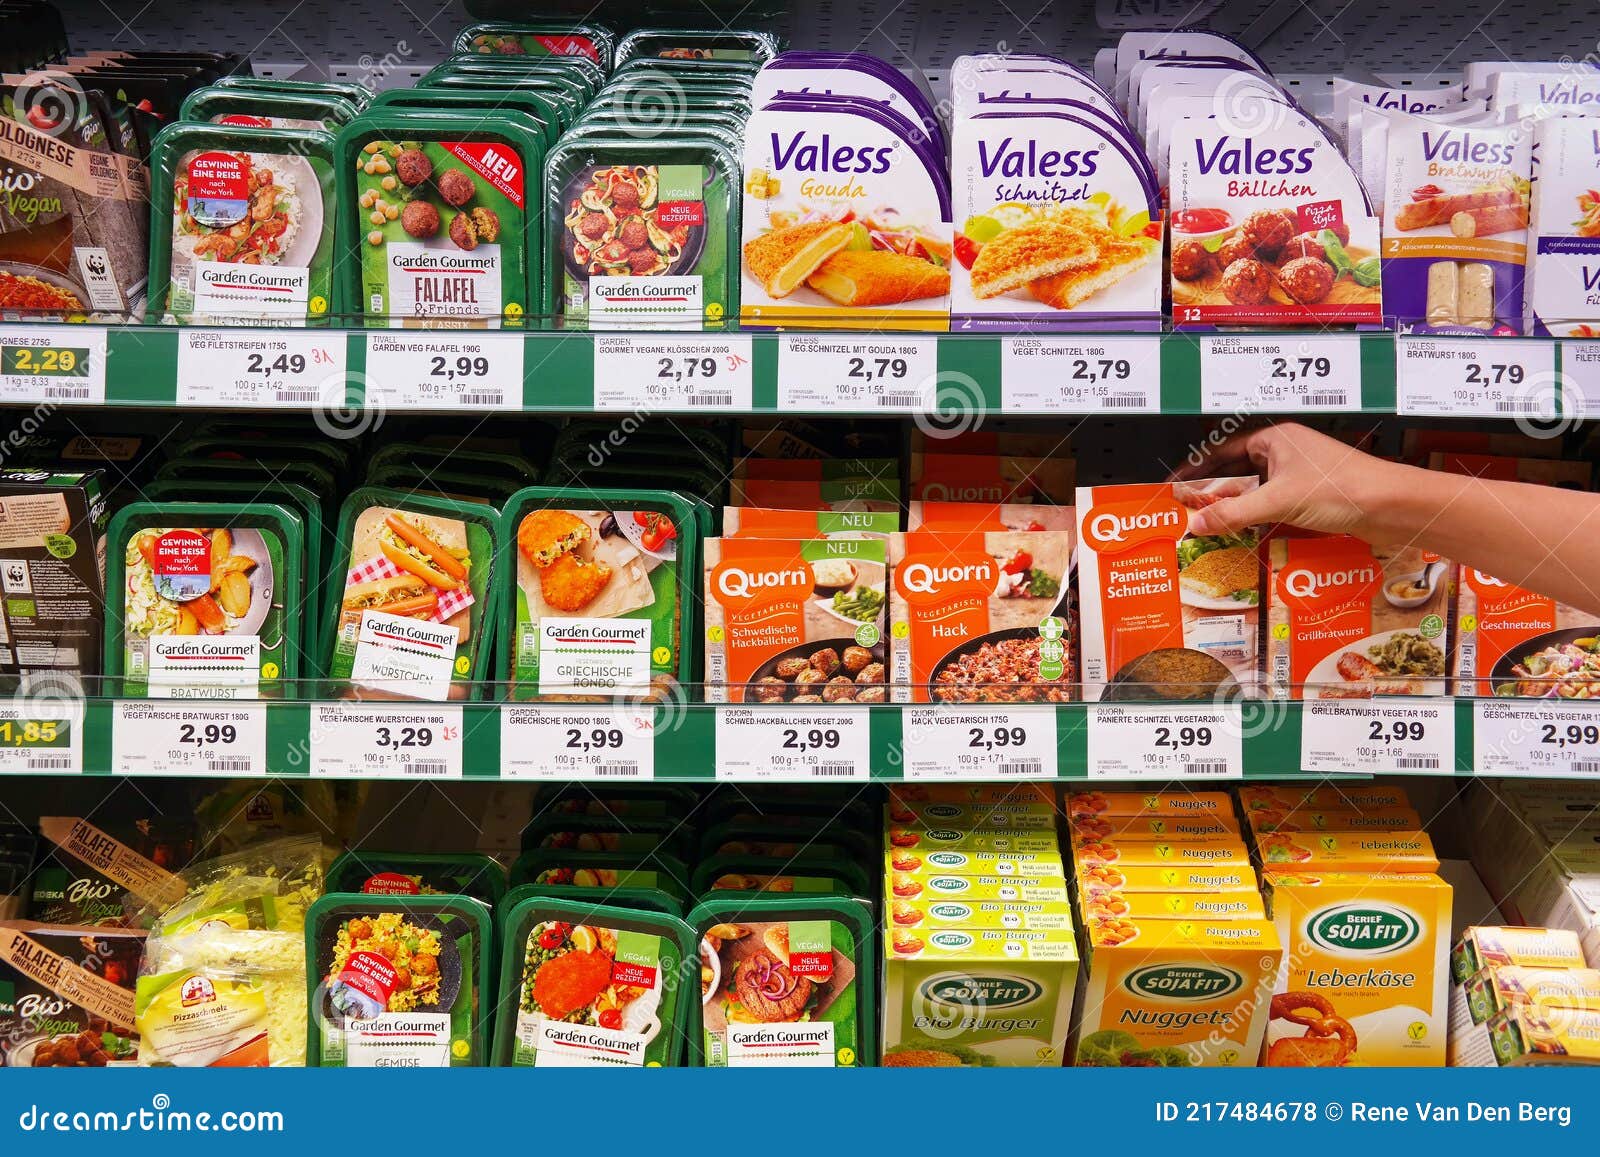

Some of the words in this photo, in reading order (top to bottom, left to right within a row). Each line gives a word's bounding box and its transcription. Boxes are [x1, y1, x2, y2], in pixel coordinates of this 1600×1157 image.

[771, 131, 892, 174] Valess
[1422, 130, 1515, 165] Valess
[978, 138, 1099, 178] Valess
[1195, 136, 1315, 175] Valess
[195, 160, 239, 170] GEWINNE
[481, 148, 518, 182] NEU
[192, 169, 214, 179] EINE
[216, 170, 242, 180] REISE
[209, 180, 226, 188] nach
[800, 176, 868, 198] Gouda
[1227, 180, 1317, 197] Bällchen
[200, 187, 215, 196] New
[217, 188, 234, 197] York
[666, 189, 695, 197] VEGAN
[995, 183, 1091, 203] Schnitzel
[392, 252, 438, 269] Garden
[440, 255, 495, 270] Gourmet
[202, 269, 246, 284] Garden
[250, 274, 303, 287] Gourmet
[415, 278, 478, 303] FALAFEL
[596, 284, 639, 296] Garden
[642, 284, 696, 296] Gourmet
[1184, 309, 1200, 320] 12
[31, 338, 51, 346] 275G
[373, 344, 406, 352] GARDEN
[790, 345, 851, 353] VEG.SCHNITZEL
[868, 346, 896, 354] GOUDA
[1407, 342, 1435, 350] VALESS
[1041, 348, 1084, 356] SCHNITZEL
[1086, 348, 1104, 356] 180G
[1407, 351, 1455, 359] BRATWURST
[1458, 352, 1476, 360] 180G
[248, 354, 306, 377] 2,49
[430, 356, 489, 380] 2,99
[658, 358, 717, 382] 2,79
[848, 358, 907, 381] 2,79
[1072, 360, 1130, 384] 2,79
[1272, 358, 1331, 382] 2,79
[1466, 364, 1524, 387] 2,79
[434, 385, 439, 393] g
[450, 384, 465, 393] 1,57
[842, 515, 873, 527] NEU
[1091, 510, 1179, 542] Quorn
[161, 539, 202, 547] GEWINNE
[827, 543, 859, 554] NEU
[158, 548, 180, 556] EINE
[182, 548, 206, 556] REISE
[174, 556, 191, 564] nach
[1112, 556, 1163, 567] FLEISCHFREI
[166, 564, 181, 572] New
[182, 564, 199, 572] York
[1110, 568, 1167, 583] Panierte
[718, 567, 807, 597] Quorn
[903, 563, 991, 594] Quorn
[1285, 566, 1375, 598] Quorn
[1107, 580, 1172, 599] Schnitzel
[731, 602, 799, 622] VEGETARISCH
[917, 599, 983, 618] VEGETARISCH
[546, 624, 589, 639] Garden
[592, 627, 646, 639] Gourmet
[731, 624, 798, 637] Schwedische
[932, 623, 968, 637] Hack
[1480, 619, 1551, 630] Geschnetzeltes
[366, 619, 405, 635] Garden
[407, 625, 454, 646] Gourmet
[156, 642, 199, 656] Garden
[201, 644, 254, 655] Gourmet
[732, 635, 800, 649] Hackbällchen
[556, 665, 633, 677] GRIECHISCHE
[122, 712, 180, 720] VEGETARISCHE
[182, 712, 229, 721] BRATWURST
[231, 713, 249, 721] 180G
[320, 715, 374, 723] VEGETARISCHE
[376, 716, 425, 724] WUERSTCHEN
[1312, 707, 1380, 717] GRILLBRATWURST
[1383, 709, 1418, 717] VEGETAR
[1484, 711, 1553, 720] GESCHNETZELTES
[912, 717, 933, 725] HACK
[991, 716, 1008, 724] 175G
[1097, 716, 1132, 724] PANIERTE
[179, 724, 236, 748] 2,99
[376, 728, 432, 750] 3,29
[969, 728, 1026, 751] 2,99
[1155, 728, 1212, 750] 2,99
[1369, 721, 1424, 744] 2,99
[1541, 725, 1599, 747] 2,99
[566, 729, 623, 752] 2,99
[782, 730, 840, 752] 2,99
[1169, 798, 1218, 810] Nuggets
[71, 822, 118, 861] FALAFEL
[1361, 840, 1422, 850] Leberkäse
[68, 839, 111, 871] ORIENTALISCH
[371, 879, 411, 889] GEWINNE
[80, 898, 124, 918] Vegan
[1347, 914, 1382, 924] BERIEF
[1006, 932, 1046, 941] Burger
[1327, 924, 1372, 940] SOJA
[1373, 924, 1402, 940] FIT
[796, 941, 824, 949] VEGAN
[10, 936, 65, 978] FALAFEL
[623, 952, 650, 962] VEGAN
[801, 957, 820, 965] NEUE
[11, 954, 59, 988] ORIENTALISCH
[358, 953, 396, 978] GEWINNE
[625, 968, 644, 977] NEUE
[792, 964, 829, 972] REZEPTUR!
[351, 960, 370, 975] EINE
[370, 967, 392, 987] REISE
[1167, 971, 1205, 979] BERIEF
[1294, 968, 1307, 976] Art
[1306, 968, 1416, 988] Leberkäse
[964, 980, 1002, 989] BERIEF
[1147, 977, 1192, 990] SOJA
[1194, 976, 1228, 991] FIT
[942, 986, 990, 1000] SOJA
[993, 987, 1025, 999] FIT
[350, 1019, 394, 1032] Garden
[394, 1021, 446, 1032] Gourmet
[913, 1015, 952, 1030] Bio
[960, 1015, 1043, 1031] Burger
[1119, 1009, 1233, 1028] Nuggets
[545, 1028, 585, 1045] Garden
[589, 1034, 642, 1052] Gourmet
[732, 1030, 776, 1044] Garden
[777, 1030, 829, 1043] Gourmet
